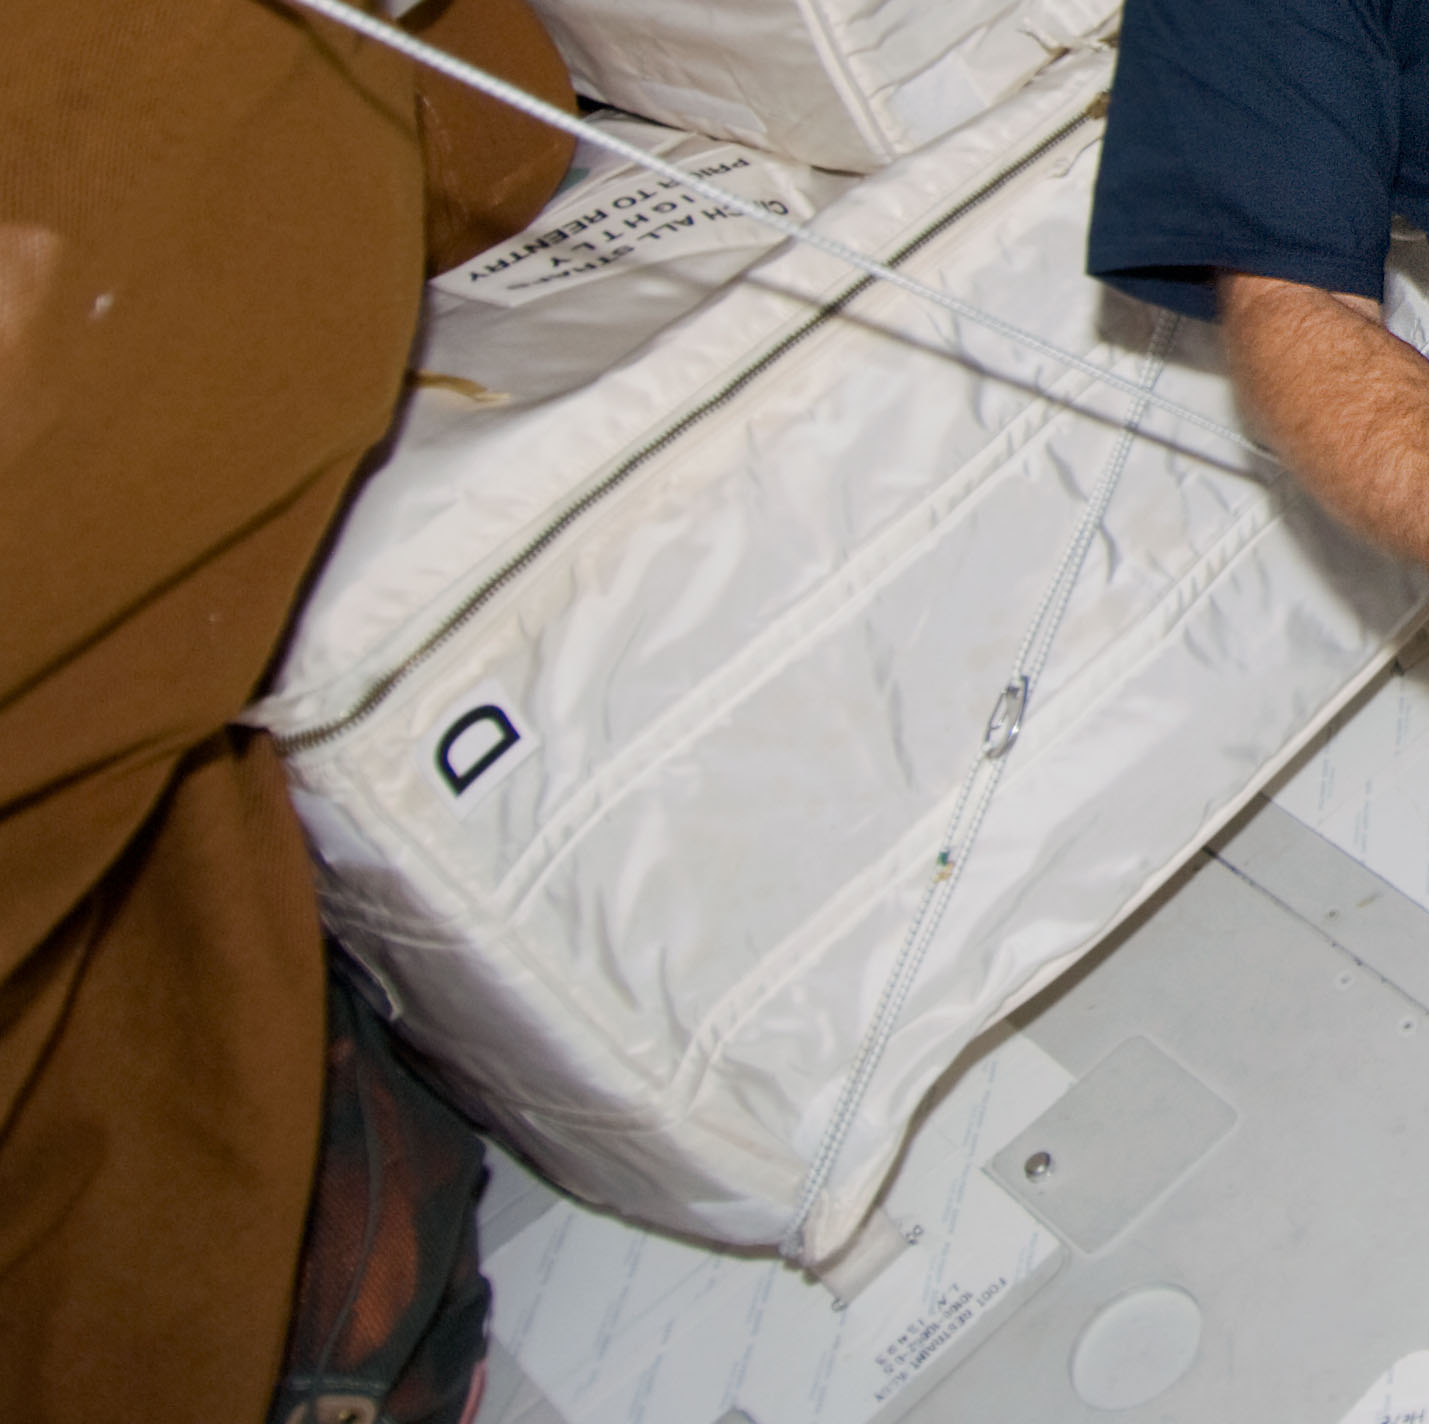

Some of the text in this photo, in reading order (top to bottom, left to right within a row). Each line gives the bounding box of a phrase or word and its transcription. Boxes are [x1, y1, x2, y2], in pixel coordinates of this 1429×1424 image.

[549, 194, 699, 268] IGHTLY
[612, 188, 657, 212] TO
[637, 215, 692, 246] ALL
[469, 209, 606, 283] REENTRY
[437, 702, 522, 798] D
